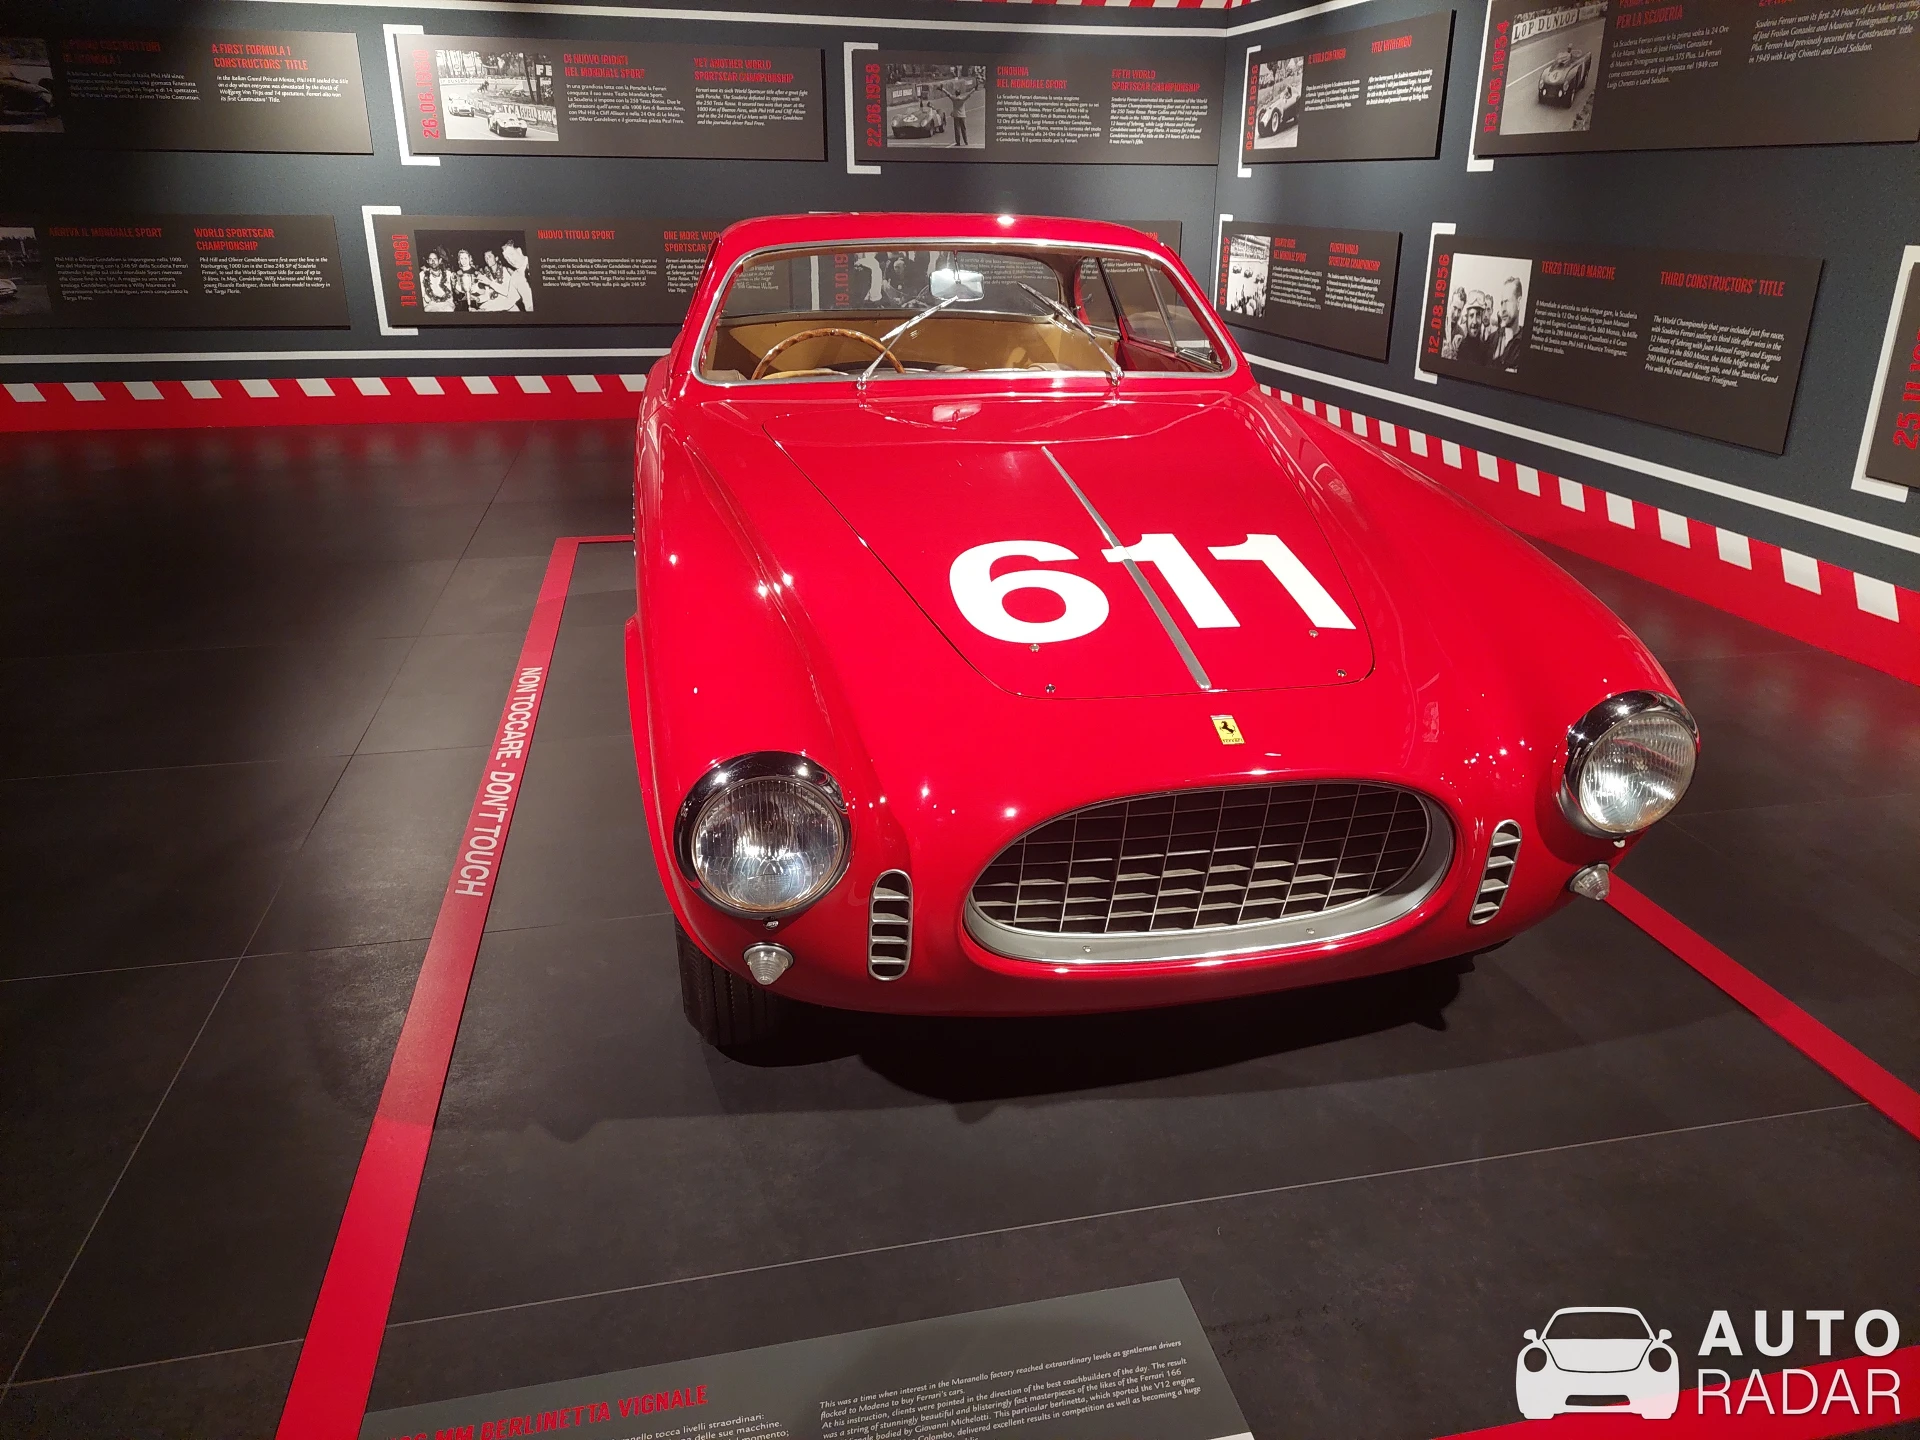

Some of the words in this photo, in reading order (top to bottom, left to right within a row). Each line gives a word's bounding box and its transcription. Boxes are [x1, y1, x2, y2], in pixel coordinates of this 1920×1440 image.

[1538, 10, 1576, 31] DUNLOP
[1644, 5, 1683, 25] SCUDERIA
[212, 44, 219, 54] A
[220, 44, 244, 55] FIRST
[245, 45, 285, 56] FORMULA
[284, 60, 309, 70] TITLE
[694, 58, 708, 68] YET
[710, 58, 743, 68] ANOTHER
[745, 59, 771, 69] WORLD
[1132, 70, 1156, 80] WORLD
[1484, 20, 1509, 133] 13.06.1954
[1045, 80, 1067, 90] SPORT
[865, 63, 882, 147] 22.06.1958
[194, 228, 224, 238] WORLD
[225, 228, 275, 238] SPORTSCAR
[196, 240, 258, 251] CHAMPIONSHIP
[537, 230, 563, 240] NUOVO
[564, 230, 590, 240] TITOLO
[591, 230, 615, 240] SPORT
[664, 231, 678, 240] ONE
[679, 231, 699, 240] MORE
[664, 243, 707, 252] SPORTSCAR
[392, 234, 417, 307] 11.06.1961
[1541, 261, 1561, 274] TERZO
[1563, 262, 1586, 277] TITOLO
[1586, 264, 1616, 280] MARCHE
[1660, 271, 1684, 287] THIRD
[1685, 273, 1757, 294] CONSTRUCTORS'
[1759, 279, 1785, 297] TITLE
[1428, 254, 1450, 354] 12.08.1956
[948, 533, 1357, 644] 611
[515, 666, 542, 692] NON
[495, 693, 535, 761] TOCCARE
[478, 770, 515, 823] DON'T
[455, 826, 504, 897] TOUCH
[820, 1400, 835, 1408] This
[860, 1393, 876, 1401] time
[878, 1389, 898, 1398] when
[900, 1383, 927, 1394] interest
[937, 1380, 950, 1388] the
[951, 1373, 988, 1385] Maranello
[989, 1369, 1013, 1381] factory
[1016, 1362, 1043, 1374] reached
[1045, 1356, 1091, 1369] extraordinary
[1092, 1351, 1110, 1360] levels
[1122, 1344, 1156, 1358] gentlemen
[1158, 1340, 1181, 1349] drivers
[820, 1407, 846, 1421] flocked
[858, 1401, 889, 1412] Modena
[901, 1396, 914, 1405] buy
[916, 1390, 946, 1401] Ferrari's
[948, 1388, 965, 1396] cars.
[821, 1420, 831, 1428] At
[847, 1412, 889, 1424] instruction,
[891, 1406, 915, 1416] clients
[917, 1403, 934, 1411] were
[937, 1396, 964, 1410] pointed
[975, 1392, 987, 1400] the
[989, 1387, 1021, 1398] direction
[1023, 1384, 1031, 1394] of
[1031, 1382, 1044, 1390] the
[1046, 1379, 1061, 1388] best
[1063, 1372, 1110, 1385] coachbuilders
[1112, 1368, 1121, 1378] of
[1121, 1367, 1132, 1375] the
[1135, 1365, 1149, 1374] day.
[1150, 1361, 1165, 1370] The
[1167, 1357, 1187, 1367] result
[847, 1425, 869, 1434] string
[870, 1421, 880, 1431] of
[880, 1415, 918, 1428] stunningly
[920, 1408, 953, 1421] beautiful
[955, 1405, 970, 1414] and
[972, 1398, 1011, 1411] blisteringly
[1013, 1396, 1027, 1407] fast
[1029, 1388, 1075, 1401] masterpieces
[1077, 1384, 1086, 1394] of
[1086, 1383, 1097, 1391] the
[1099, 1380, 1116, 1389] likes
[1118, 1377, 1126, 1387] of
[1126, 1376, 1137, 1384] the
[1139, 1371, 1163, 1382] Ferrari
[1166, 1368, 1181, 1377] 166
[479, 1401, 610, 1440] BERLINETTA
[617, 1384, 709, 1418] VIGNALE
[876, 1428, 900, 1439] bodied
[903, 1426, 913, 1436] by
[914, 1420, 948, 1432] Giovanni
[950, 1412, 989, 1425] Michelotti.
[1011, 1403, 1047, 1417] particular
[1049, 1396, 1087, 1408] berlinetta,
[1089, 1390, 1110, 1401] which
[1112, 1385, 1138, 1398] sported
[1140, 1383, 1152, 1391] the
[1153, 1379, 1170, 1389] V12
[1172, 1377, 1195, 1387] engine
[957, 1422, 990, 1434] delivered
[993, 1417, 1024, 1428] excellent
[1026, 1412, 1050, 1422] results
[1061, 1403, 1104, 1416] competition
[1116, 1397, 1130, 1406] well
[1142, 1390, 1177, 1401] becoming
[1183, 1385, 1201, 1395] huge
[655, 1428, 680, 1438] tocca
[683, 1422, 706, 1433] livelli
[708, 1412, 765, 1428] straordinari:
[694, 1431, 716, 1440] delle
[718, 1429, 733, 1437] sue
[736, 1421, 782, 1434] macchine.
